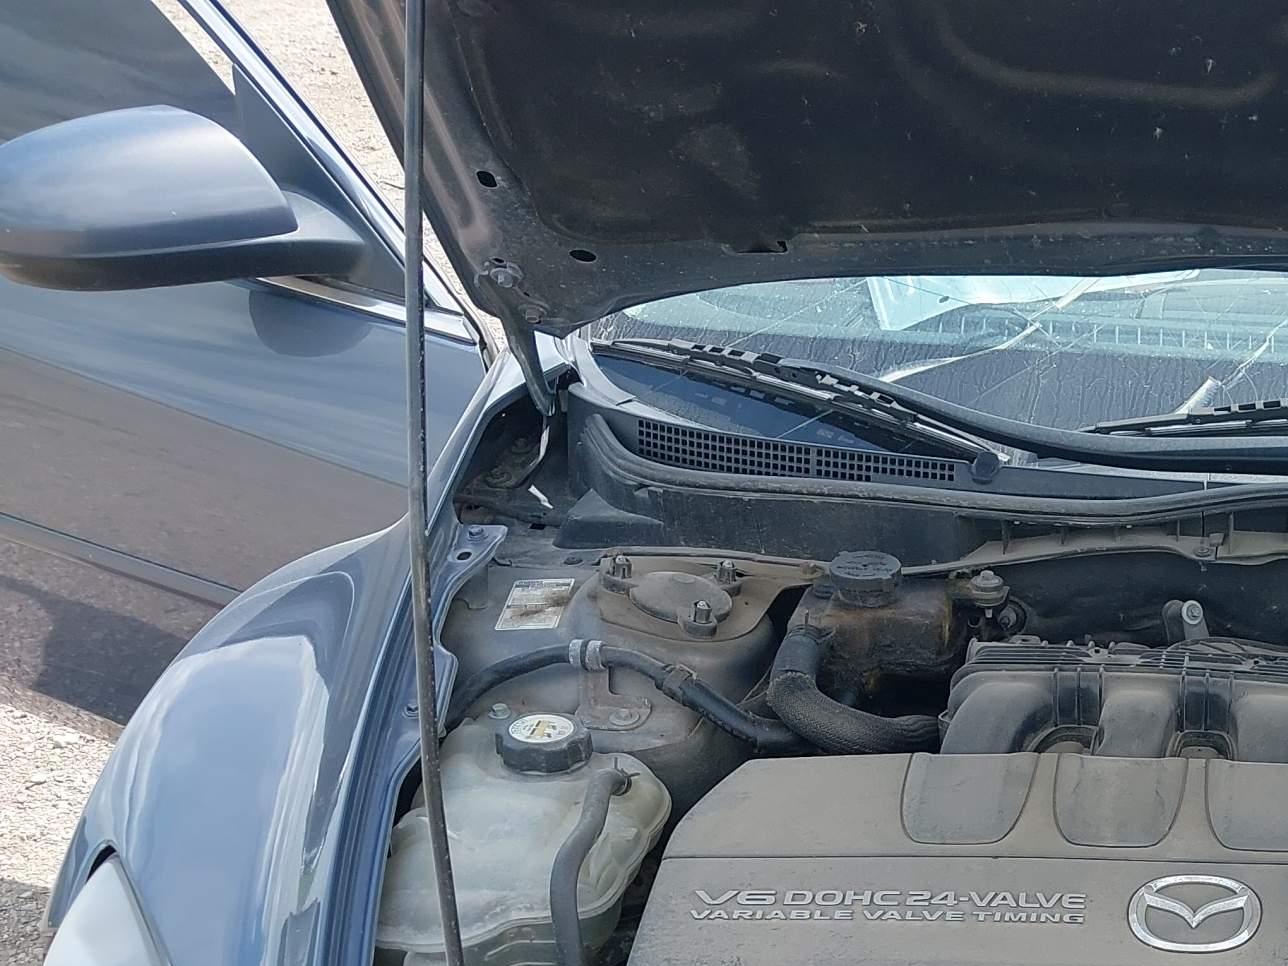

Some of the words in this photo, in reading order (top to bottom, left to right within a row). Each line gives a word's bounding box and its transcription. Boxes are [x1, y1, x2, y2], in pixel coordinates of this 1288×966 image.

[695, 889, 777, 906] V6
[783, 890, 901, 907] DOHC
[906, 890, 1087, 909] 24-VALVE
[690, 909, 854, 921] VARIABLE
[863, 910, 965, 922] VALVE
[972, 911, 1085, 924] TIMING
